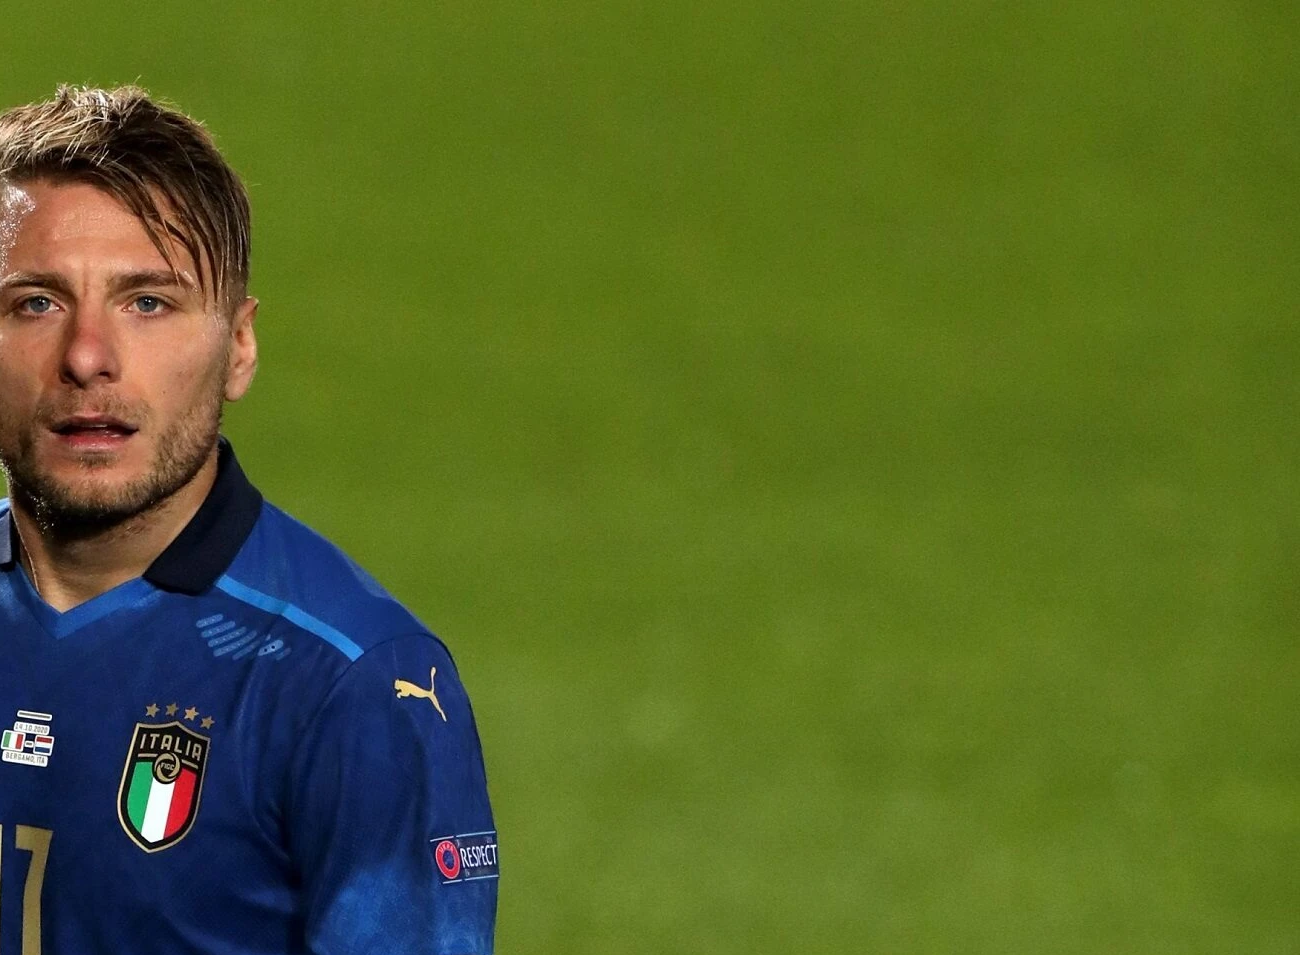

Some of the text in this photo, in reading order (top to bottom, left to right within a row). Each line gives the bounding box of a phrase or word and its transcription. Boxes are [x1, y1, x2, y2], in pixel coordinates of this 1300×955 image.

[14, 722, 49, 734] 14.10.2020
[140, 733, 202, 761] ITALIA
[460, 844, 497, 868] RESPECT
